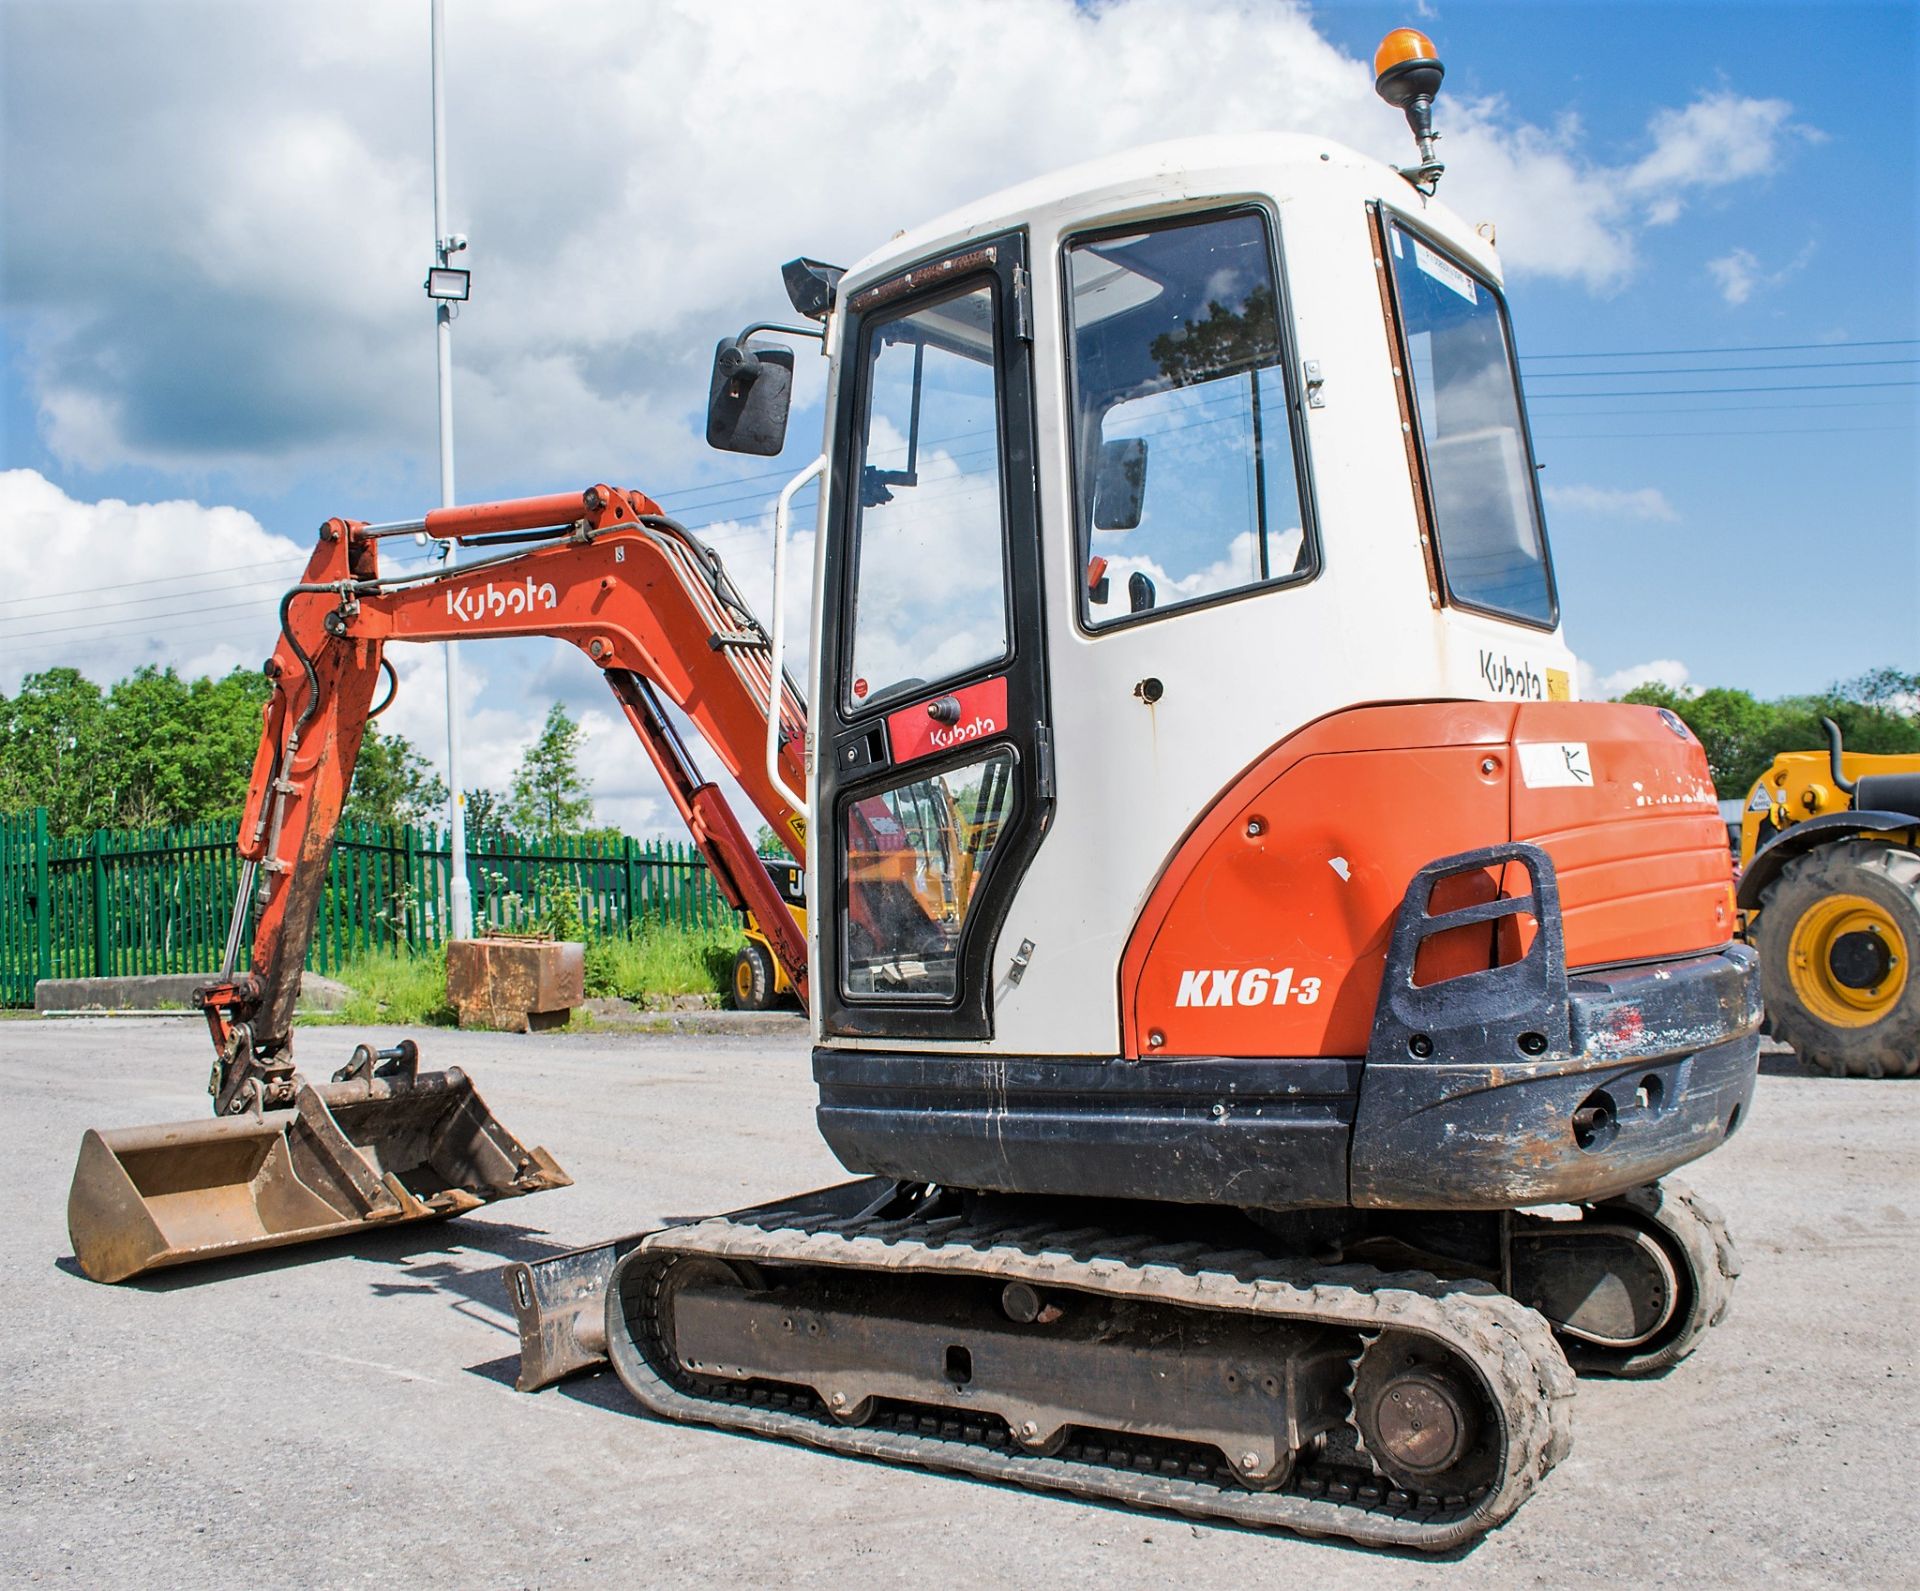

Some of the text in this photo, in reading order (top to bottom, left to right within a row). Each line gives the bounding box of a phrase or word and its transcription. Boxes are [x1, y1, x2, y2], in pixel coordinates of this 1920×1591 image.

[447, 576, 556, 622] Kubota
[1480, 650, 1541, 700] Kubota
[930, 716, 995, 747] Kubota
[790, 870, 806, 896] J
[1175, 968, 1321, 1007] KX61-3
